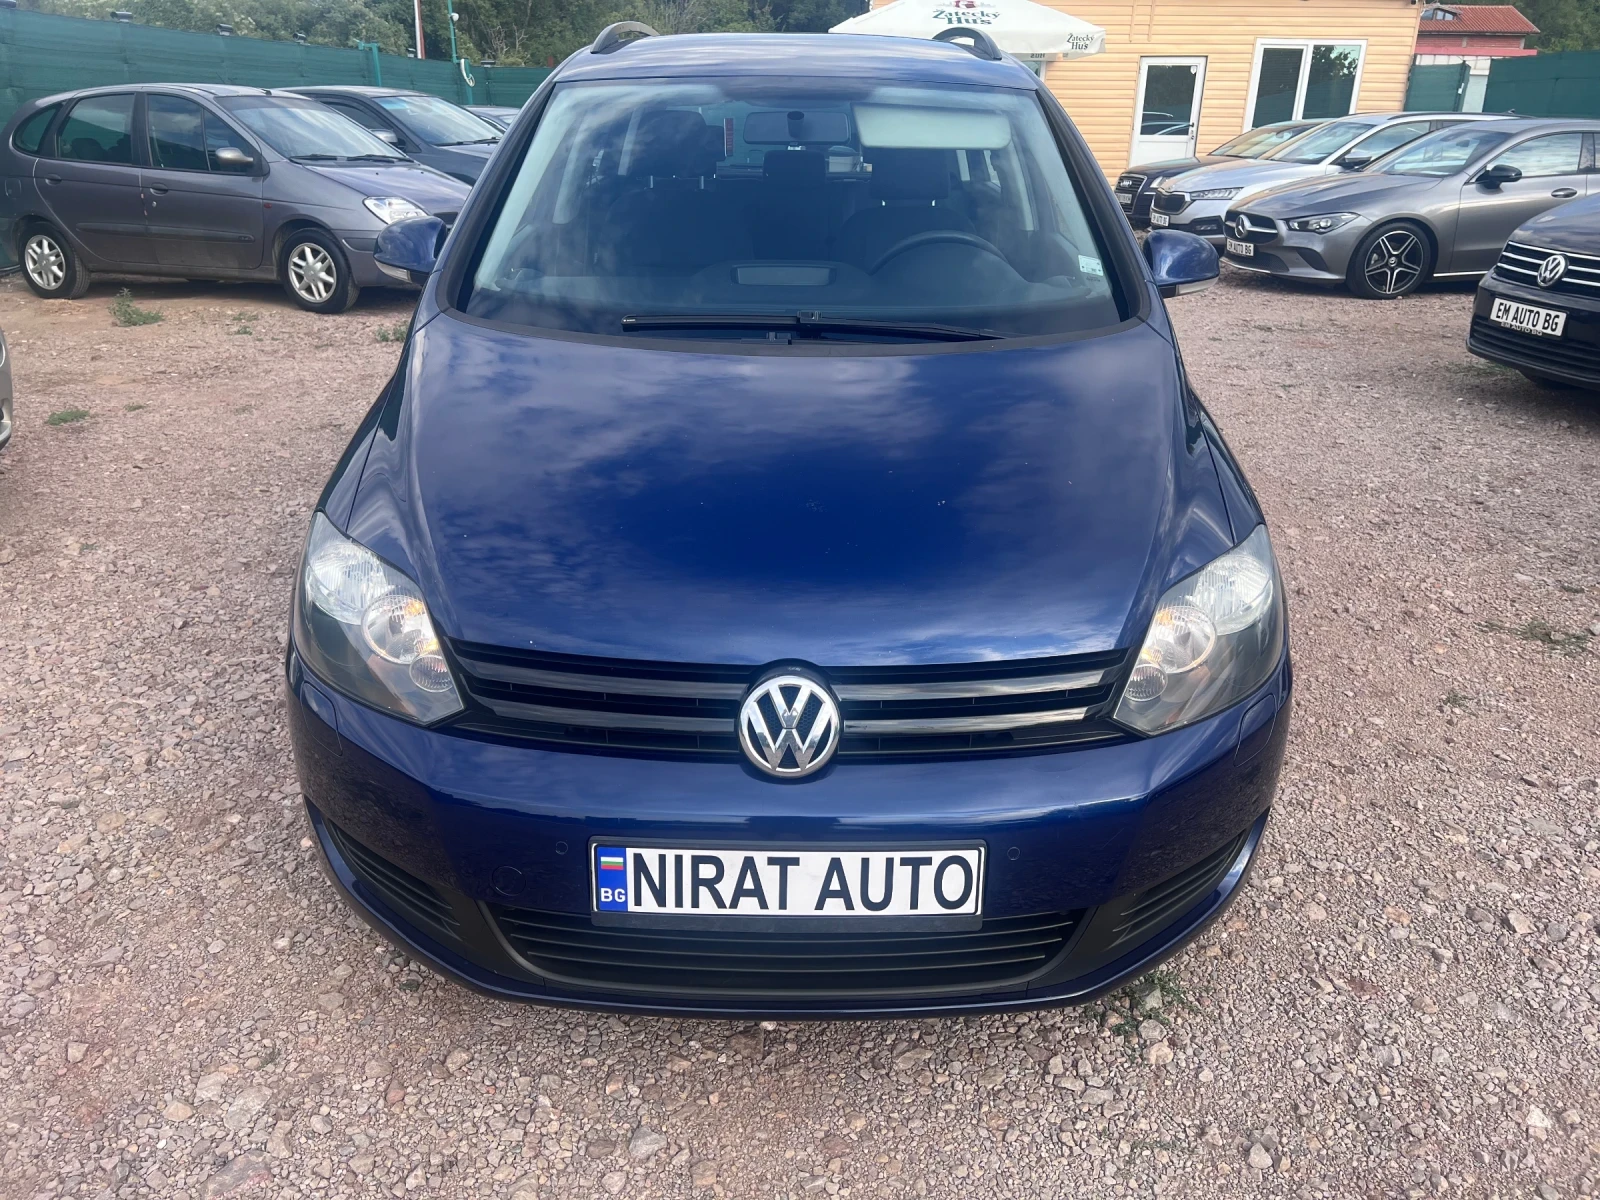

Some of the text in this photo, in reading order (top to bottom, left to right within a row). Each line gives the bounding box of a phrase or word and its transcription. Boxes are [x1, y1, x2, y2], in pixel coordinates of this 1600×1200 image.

[1245, 244, 1252, 254] BG
[1496, 302, 1560, 332] EM AUTO BG
[1501, 321, 1543, 336] EM AUTO BG
[633, 852, 974, 911] NIRAT AUTO
[600, 887, 626, 903] BG
